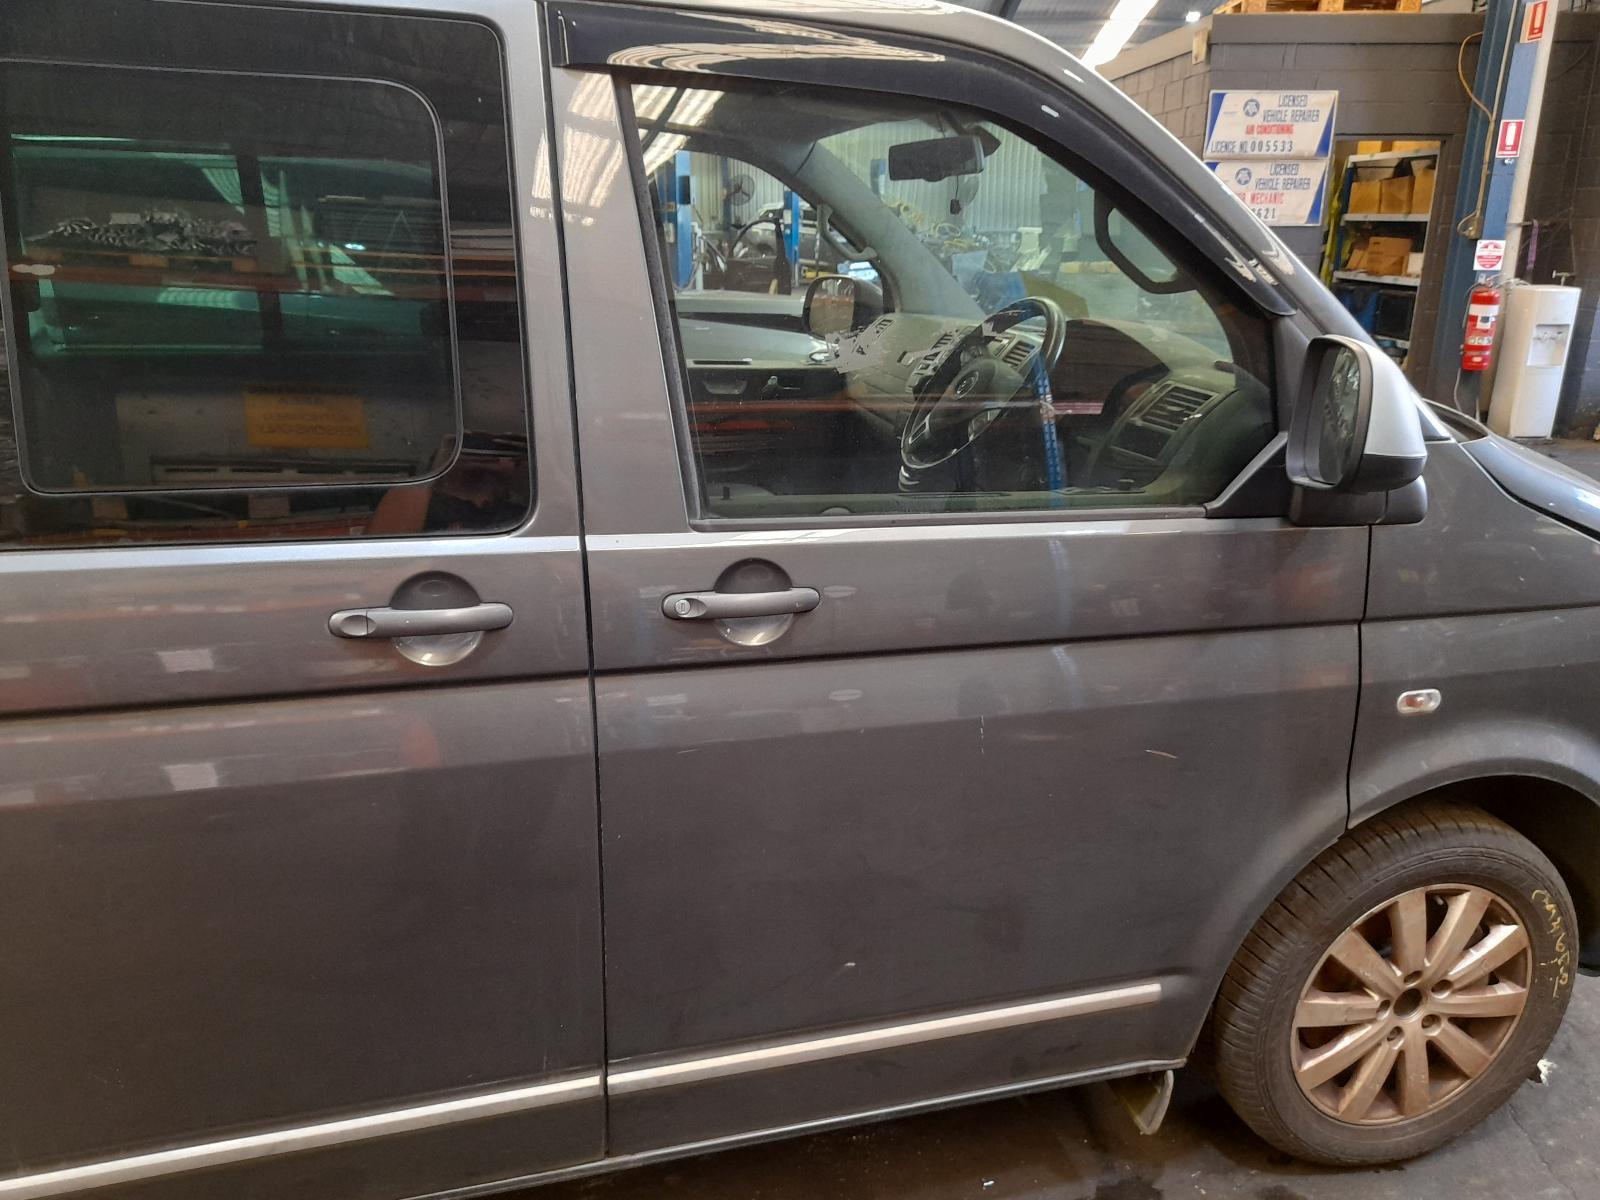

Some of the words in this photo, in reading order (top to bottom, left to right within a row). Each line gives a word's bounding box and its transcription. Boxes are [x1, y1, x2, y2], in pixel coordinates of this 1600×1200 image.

[1263, 110, 1288, 122] VEHICLE
[1291, 110, 1320, 122] REPAIRER
[1245, 125, 1255, 135] AIR
[1257, 124, 1294, 135] CONDITIONING
[1250, 140, 1294, 152] 005533
[1255, 178, 1280, 190] VEHICLE
[1282, 178, 1311, 190] REPAIRER
[1250, 193, 1285, 204] MECHANIC
